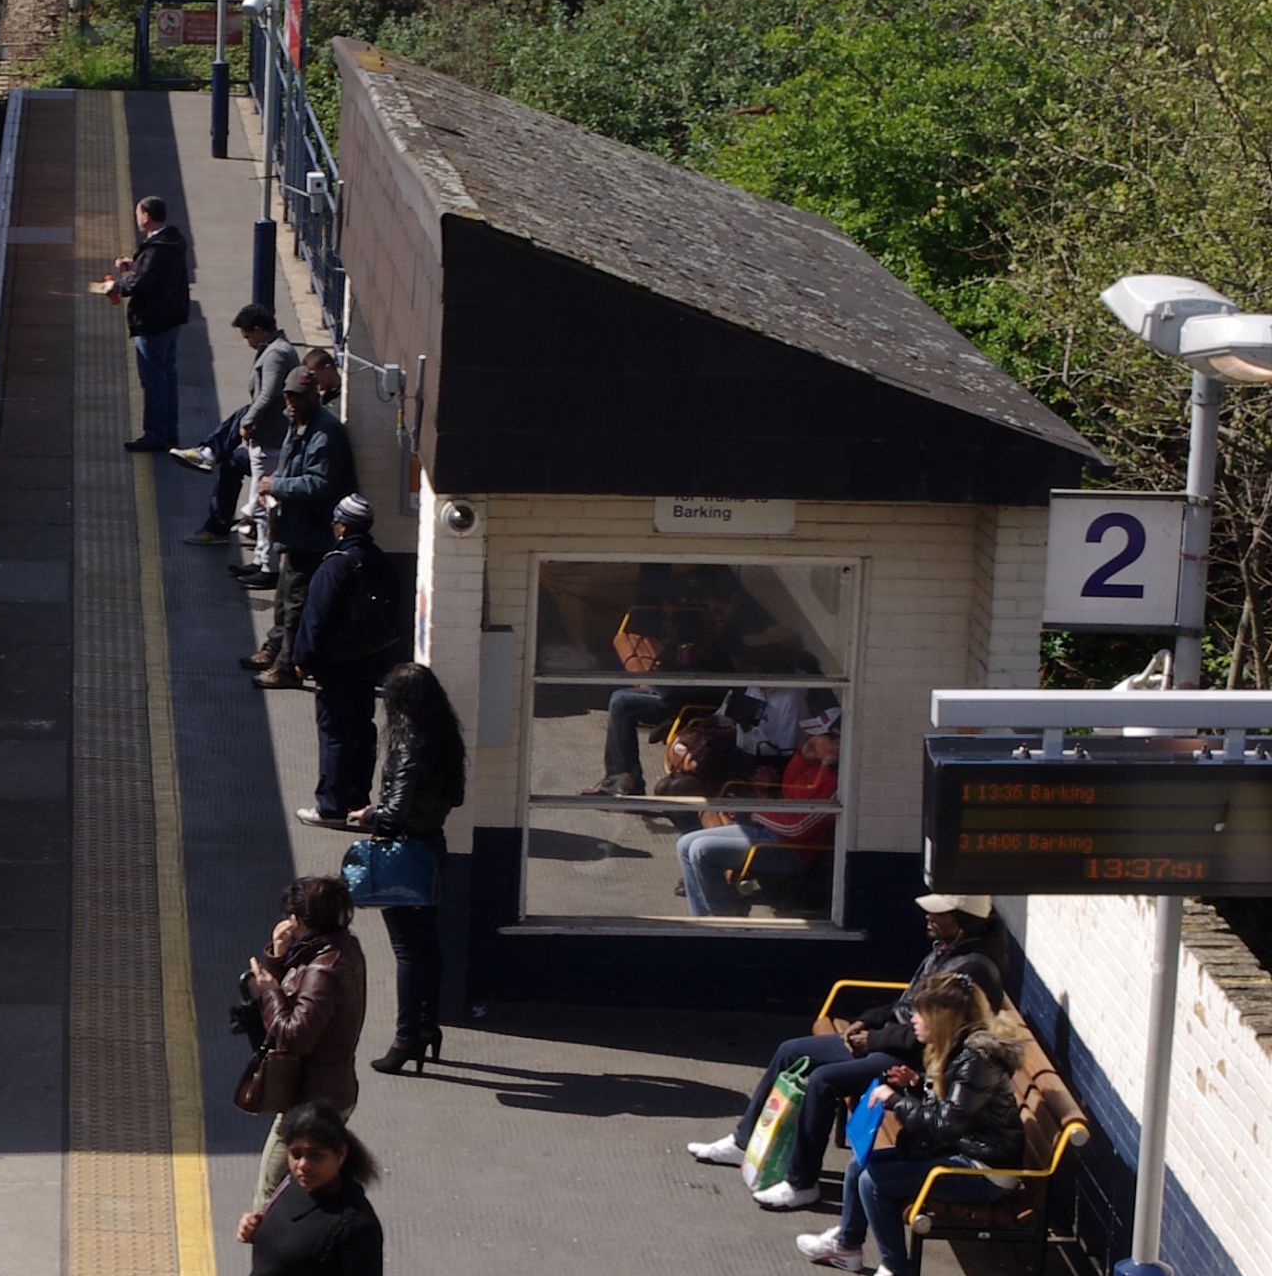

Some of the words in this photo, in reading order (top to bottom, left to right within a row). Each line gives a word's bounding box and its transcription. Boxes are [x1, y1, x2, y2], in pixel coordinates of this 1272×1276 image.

[672, 505, 732, 521] Barking
[1080, 512, 1147, 599] 2
[962, 784, 970, 801] 1
[1030, 784, 1095, 804] Barking
[959, 833, 970, 849] 3
[977, 833, 1022, 849] 14:06
[1029, 833, 1093, 854] Barking
[1088, 858, 1204, 879] 13:37:51
